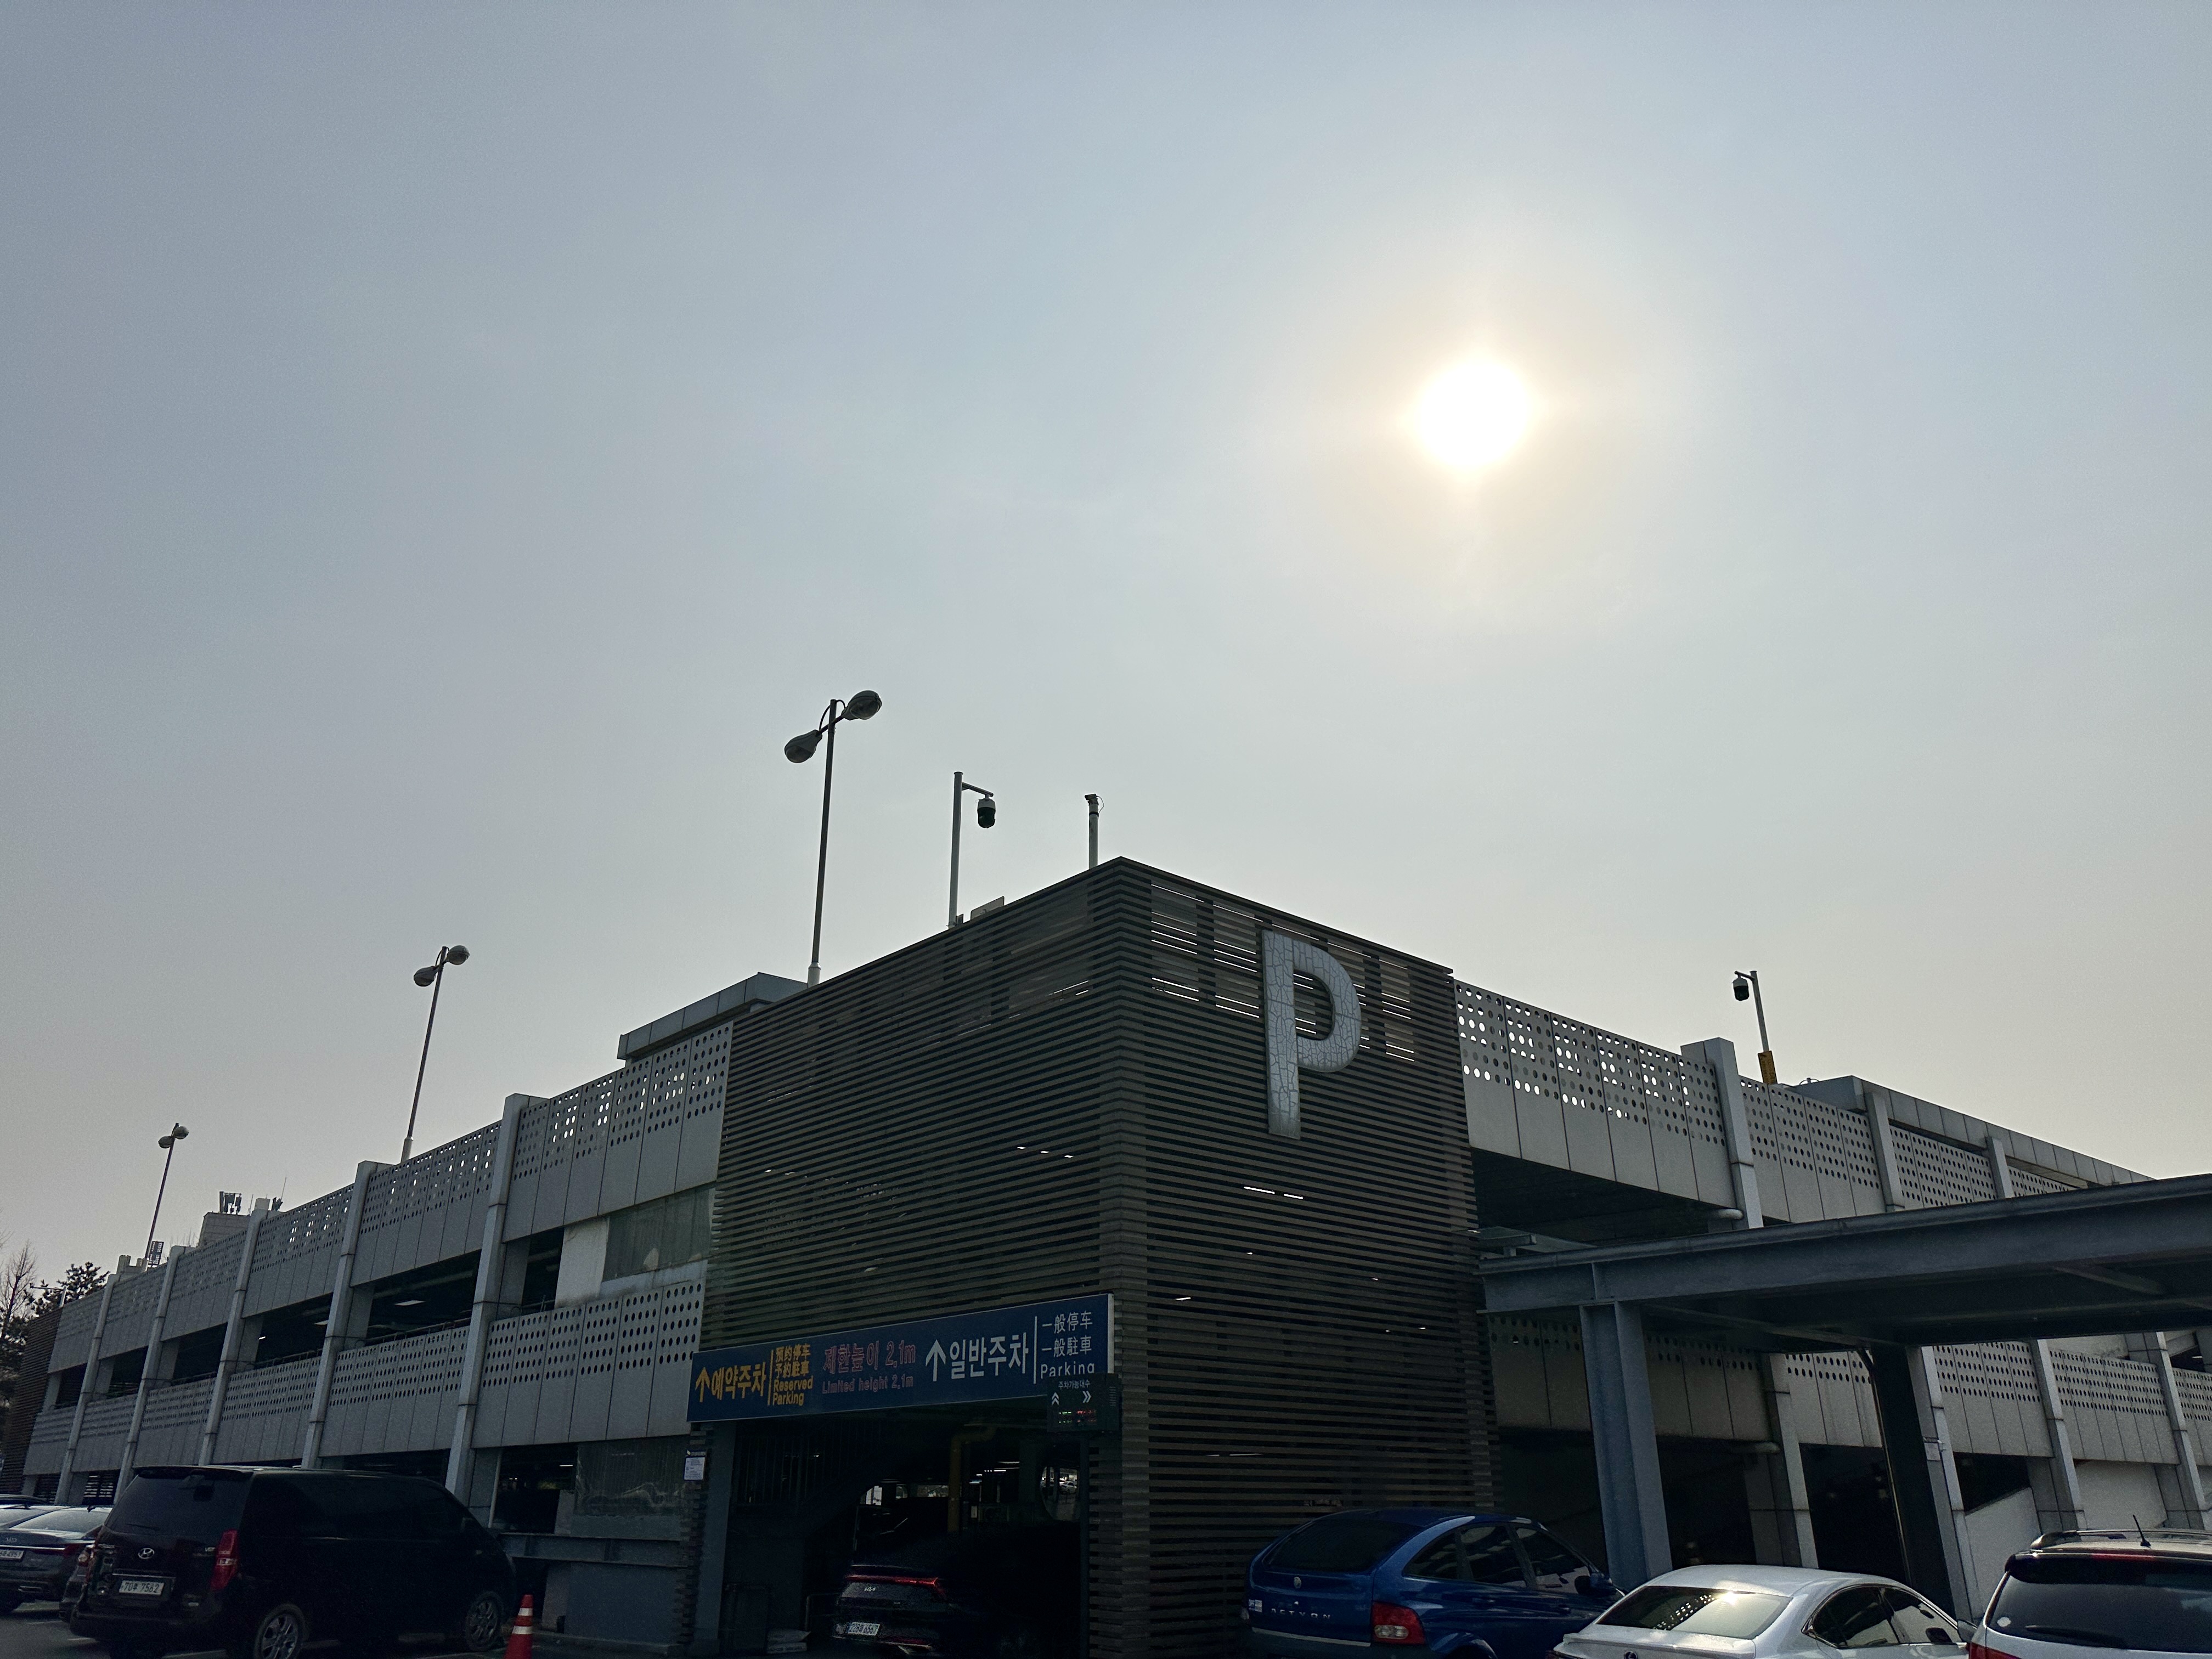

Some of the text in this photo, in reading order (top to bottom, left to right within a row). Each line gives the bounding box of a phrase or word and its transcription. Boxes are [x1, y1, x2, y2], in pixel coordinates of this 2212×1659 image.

[1263, 929, 1361, 1140] P
[1042, 1311, 1093, 1334] 一般停车
[823, 1339, 916, 1375] 제한높이 2.1m
[949, 1332, 1029, 1379] 일반주차
[1041, 1335, 1092, 1358] 一般駐車
[711, 1361, 767, 1401] 예약주차
[1040, 1361, 1095, 1379] Parking
[773, 1375, 814, 1392] Reserved
[822, 1373, 914, 1395] Limited height 2.1m
[772, 1390, 805, 1407] Parking
